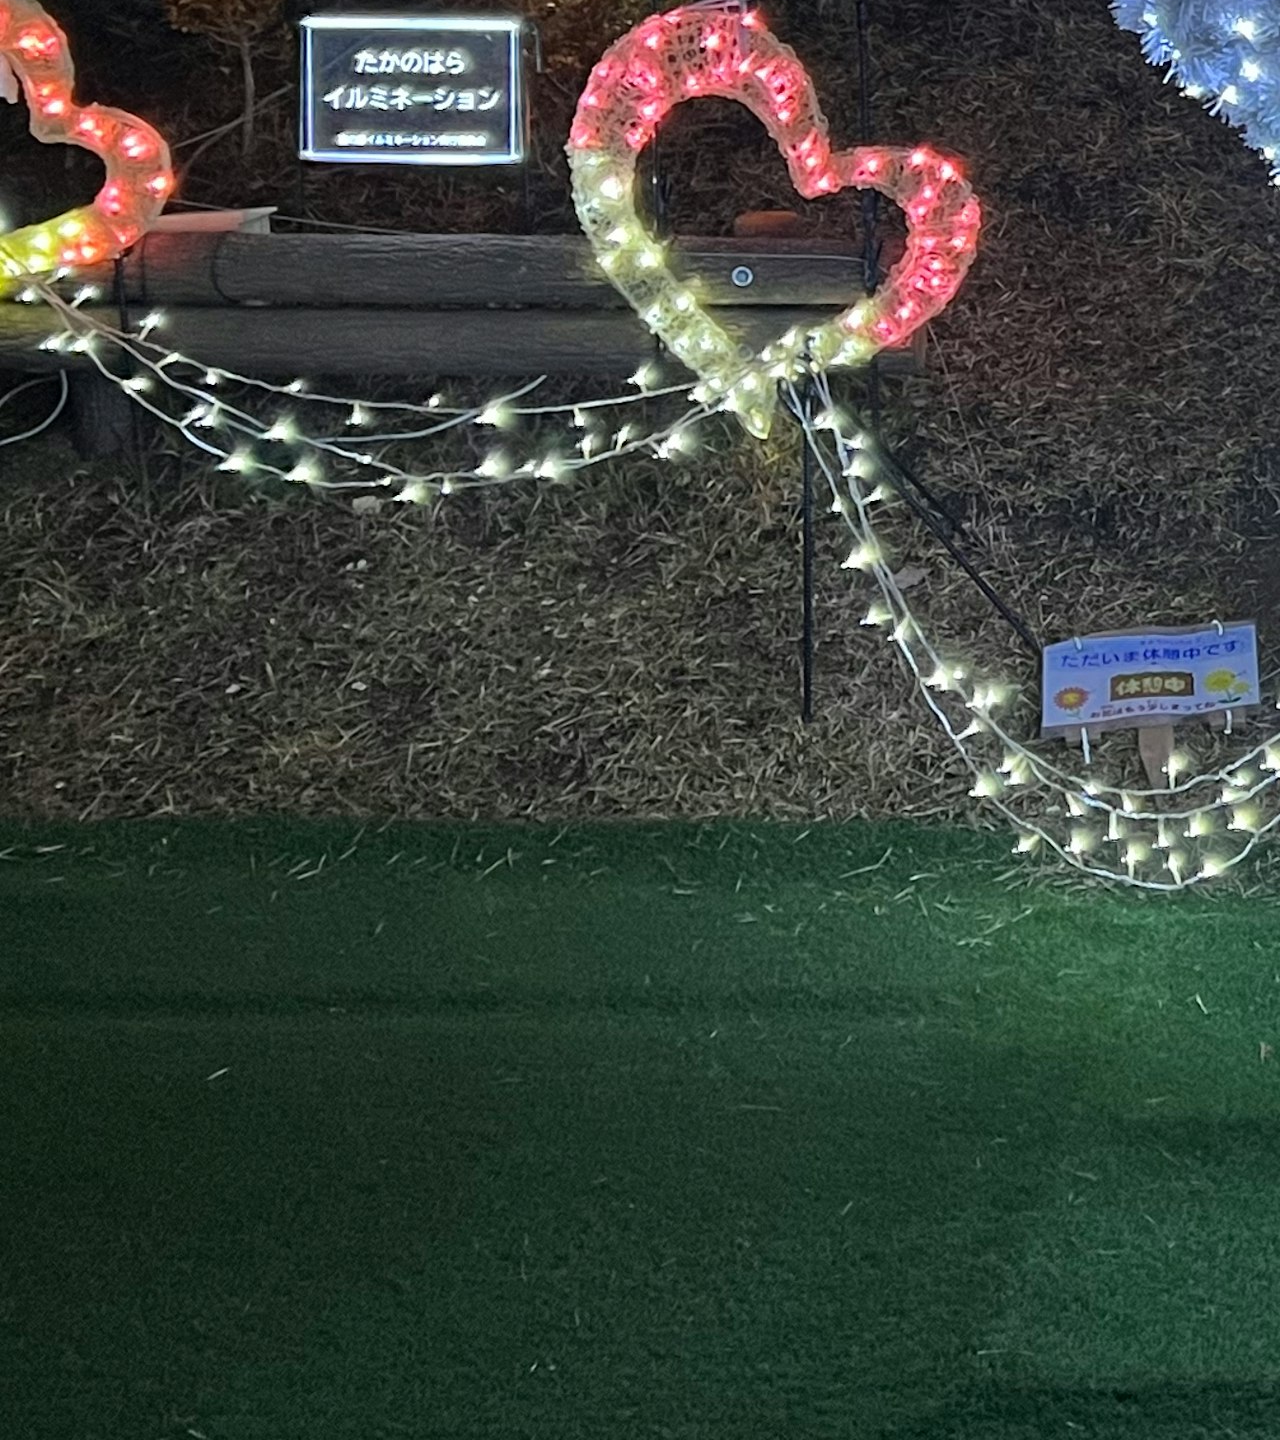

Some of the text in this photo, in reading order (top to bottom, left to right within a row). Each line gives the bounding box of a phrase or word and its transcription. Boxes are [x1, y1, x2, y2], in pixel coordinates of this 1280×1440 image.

[353, 48, 467, 75] たかのはら
[321, 84, 501, 111] イルミネーション
[1061, 640, 1238, 667] ただいま休憩中です
[1115, 676, 1186, 696] 休憩中
